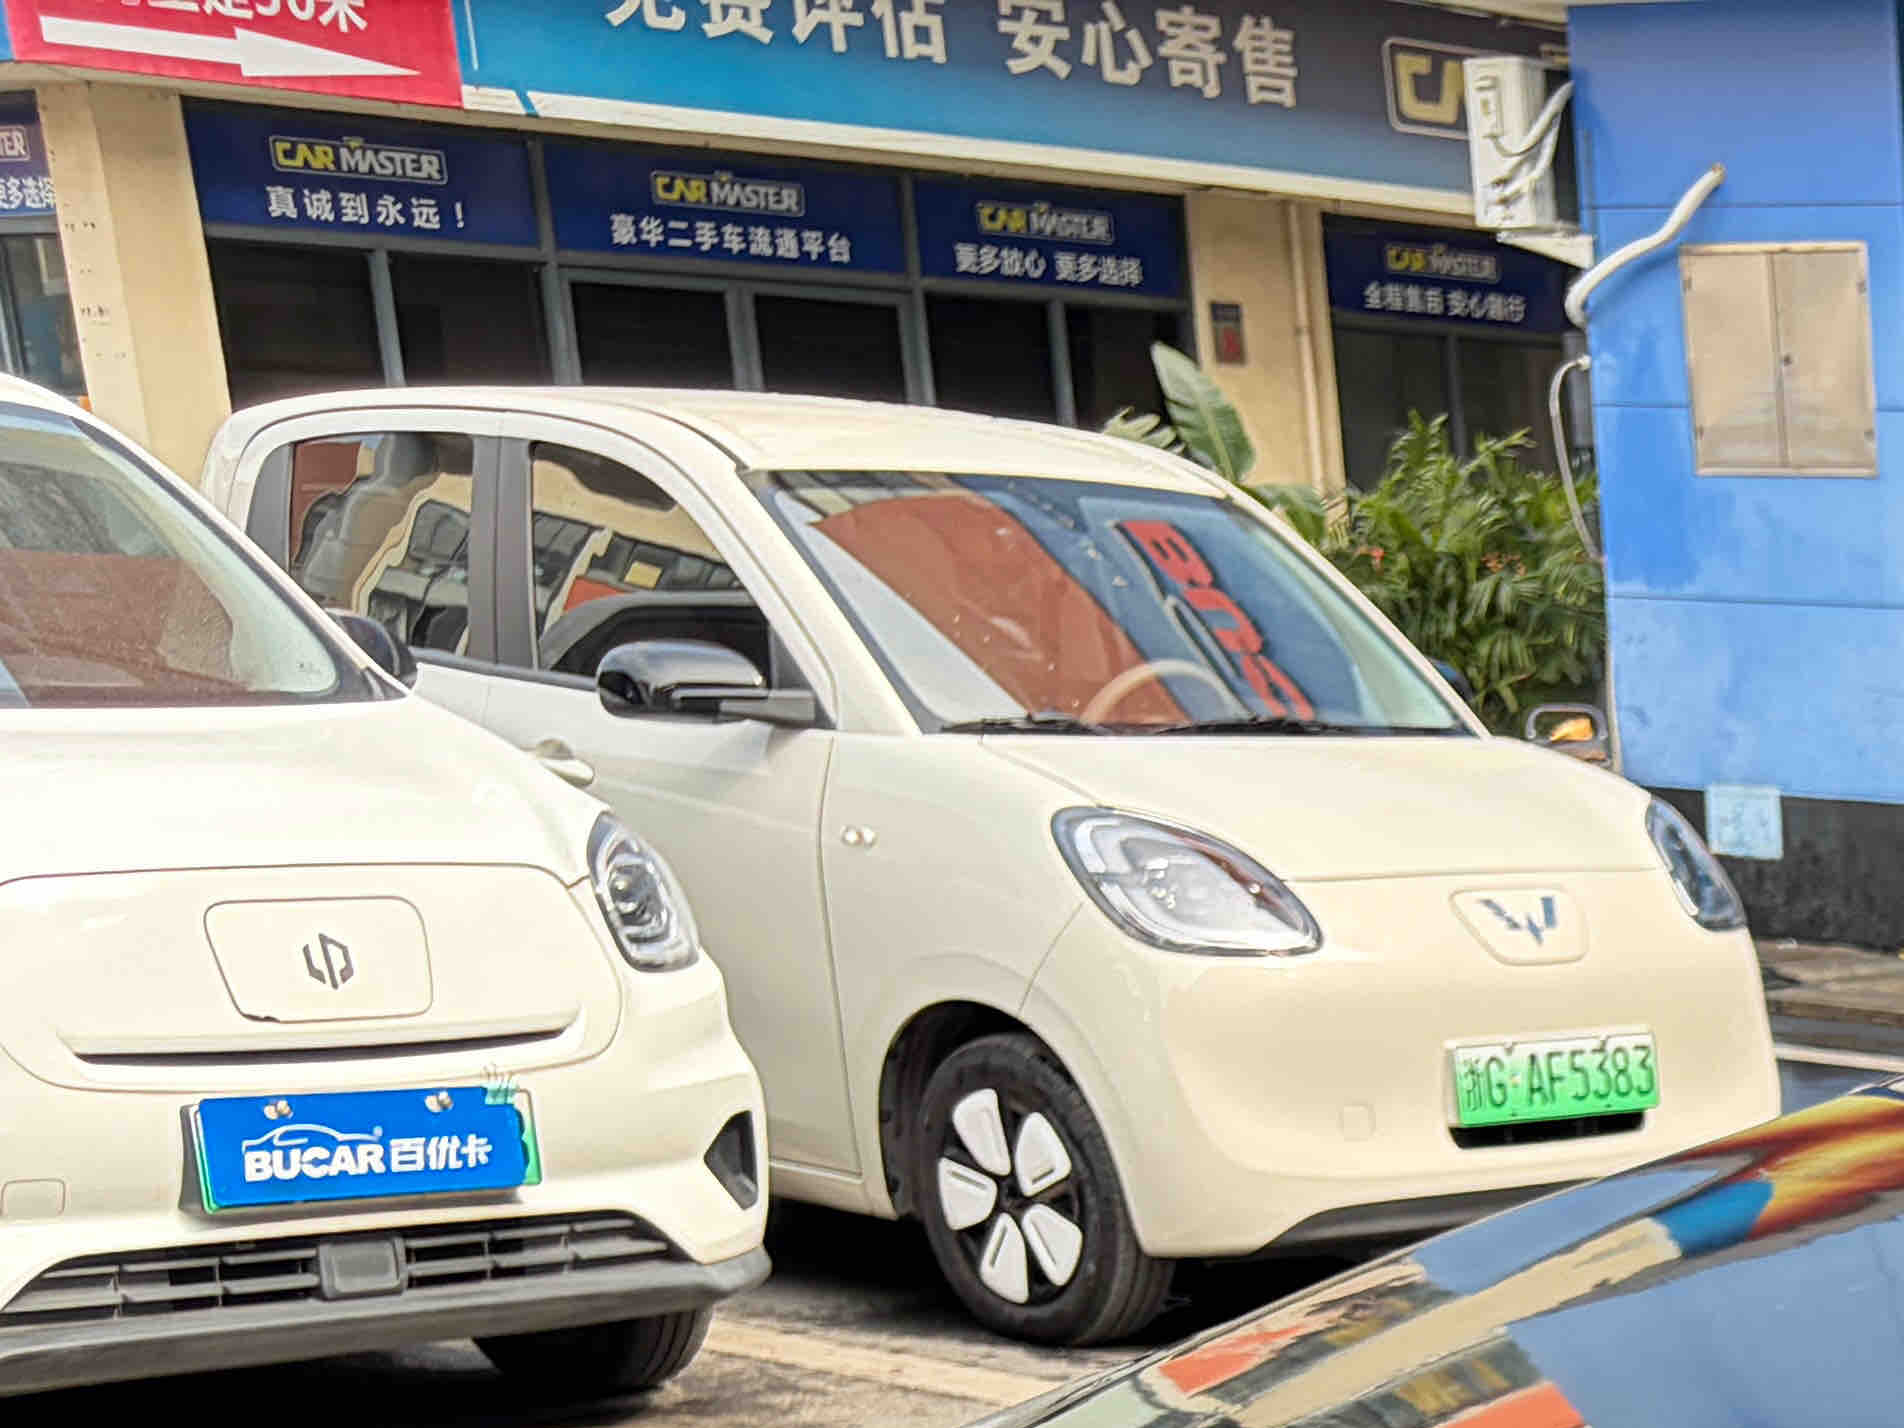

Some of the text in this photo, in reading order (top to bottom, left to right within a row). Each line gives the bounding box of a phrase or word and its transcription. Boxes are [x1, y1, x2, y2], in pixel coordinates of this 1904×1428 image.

[997, 0, 1298, 109] 安心寄售
[275, 141, 442, 181] CAR MASTER
[655, 175, 800, 212] CAR MASTER
[610, 213, 851, 264] 豪华二手车流通平台
[244, 1133, 493, 1183] BUCAR 百优卡
